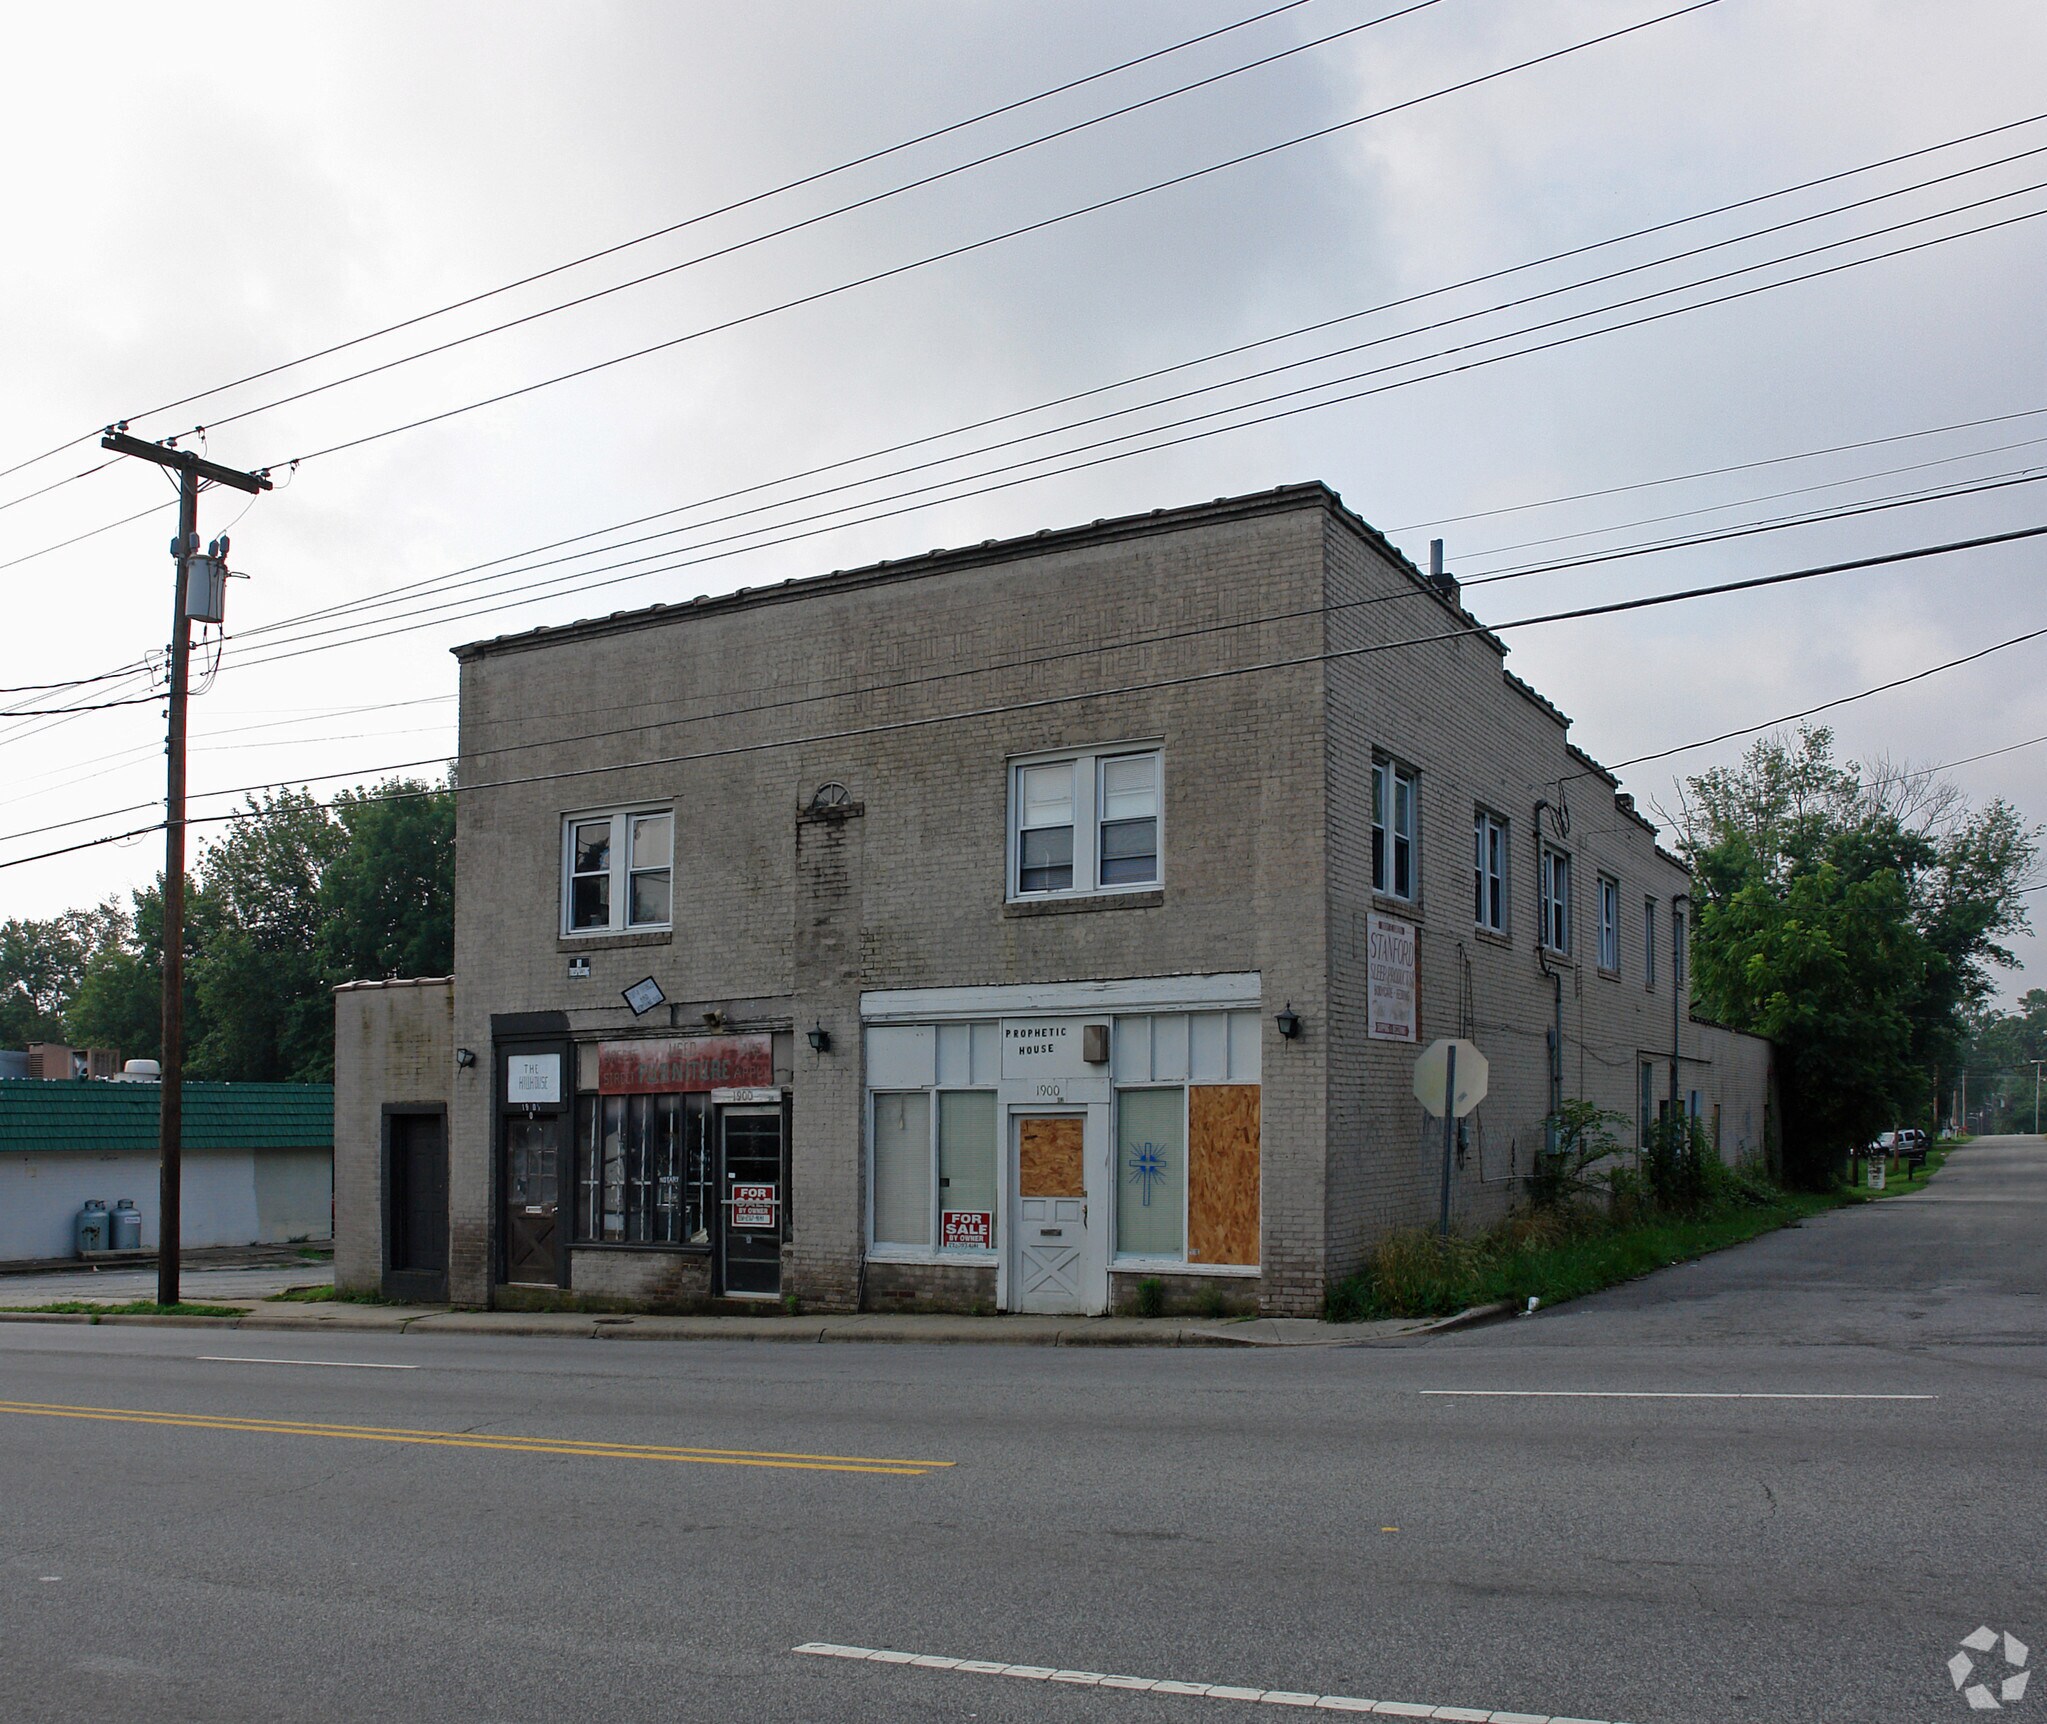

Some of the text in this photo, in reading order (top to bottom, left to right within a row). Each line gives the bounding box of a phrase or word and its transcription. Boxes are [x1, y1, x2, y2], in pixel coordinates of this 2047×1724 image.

[1370, 932, 1413, 967] STANFORD
[1370, 963, 1386, 981] SLEEP
[1005, 1028, 1067, 1038] PROPHETIC
[668, 1041, 697, 1058] USED
[1019, 1044, 1054, 1055] HOUSE
[523, 1064, 539, 1074] THE
[637, 1059, 732, 1085] FURNITURE
[603, 1072, 634, 1086] STREET
[733, 1090, 753, 1101] 1900
[1036, 1085, 1060, 1096] 1900
[740, 1188, 767, 1197] FOR
[951, 1214, 982, 1224] FOR
[945, 1223, 988, 1235] SALE
